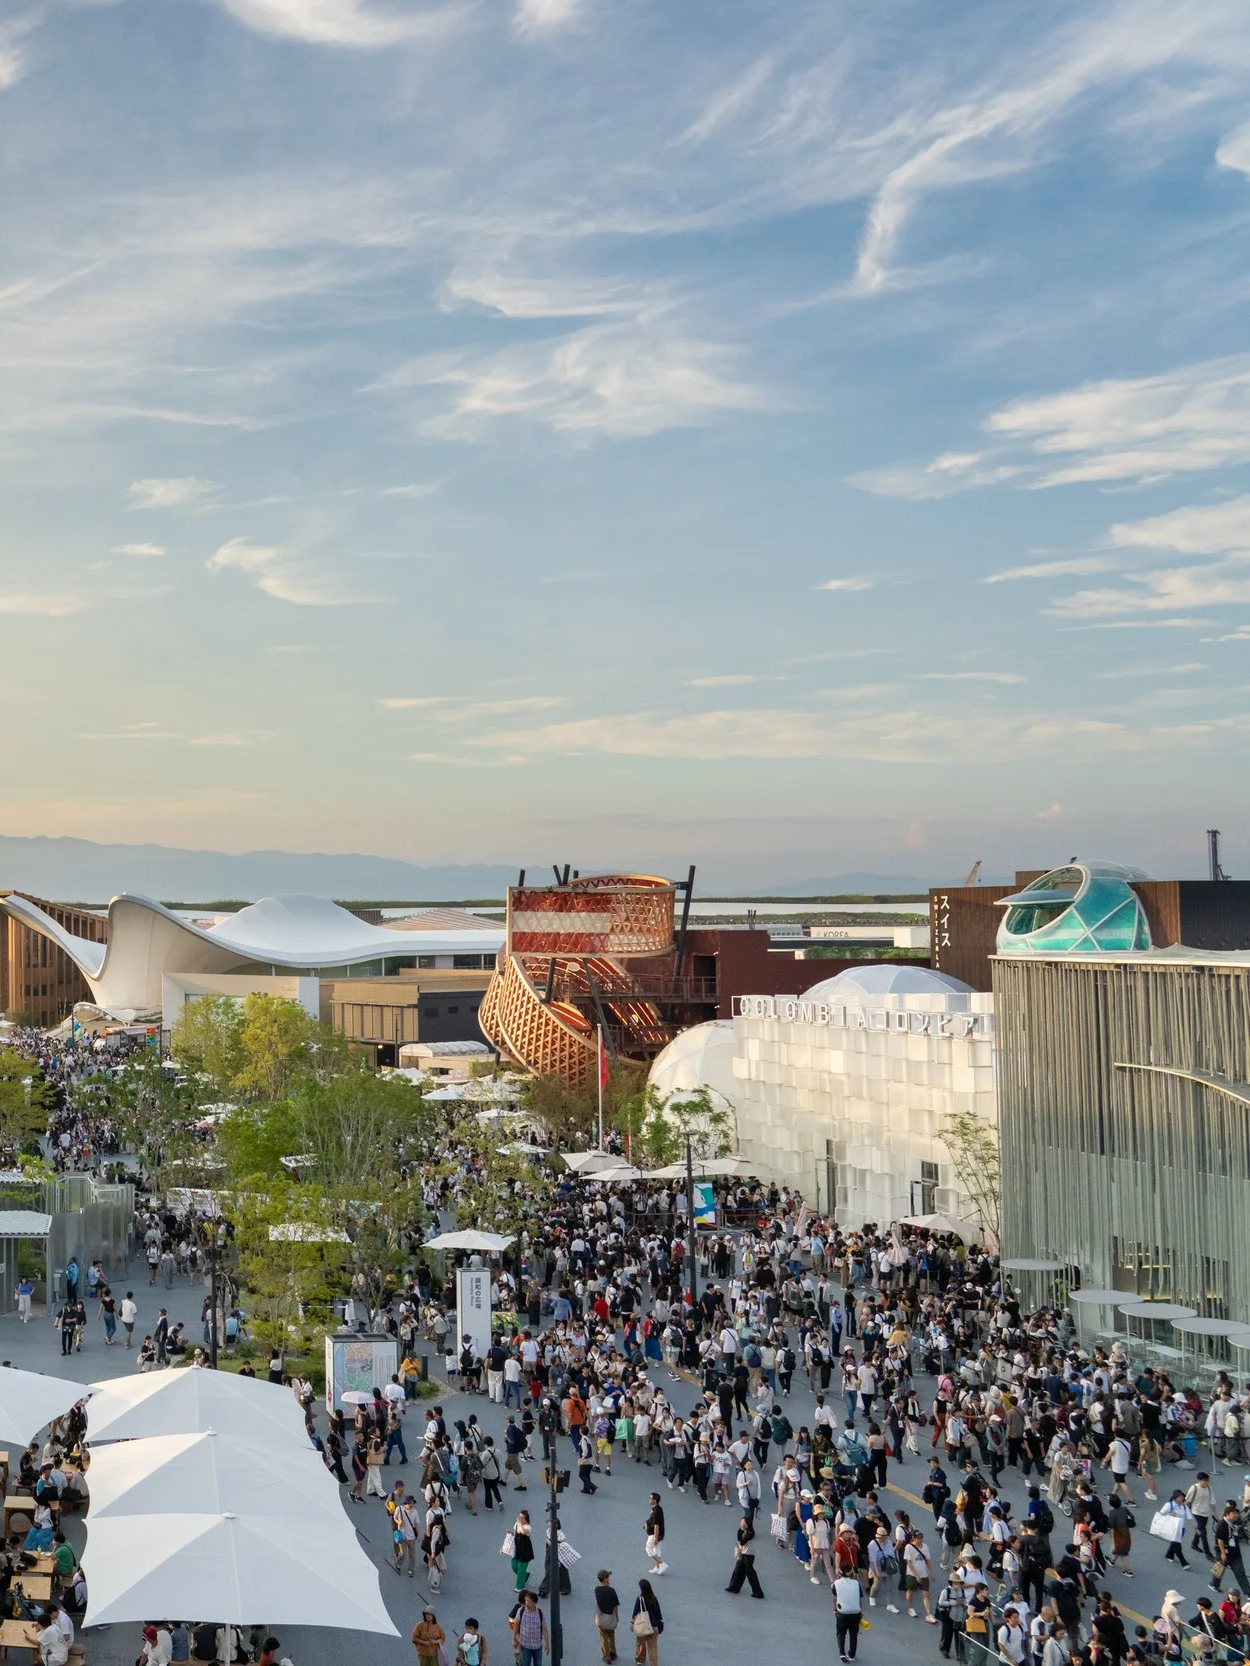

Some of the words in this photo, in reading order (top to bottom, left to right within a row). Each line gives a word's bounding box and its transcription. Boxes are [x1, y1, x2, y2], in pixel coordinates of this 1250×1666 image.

[940, 895, 950, 947] スイス
[739, 996, 867, 1028] COLOMBIA
